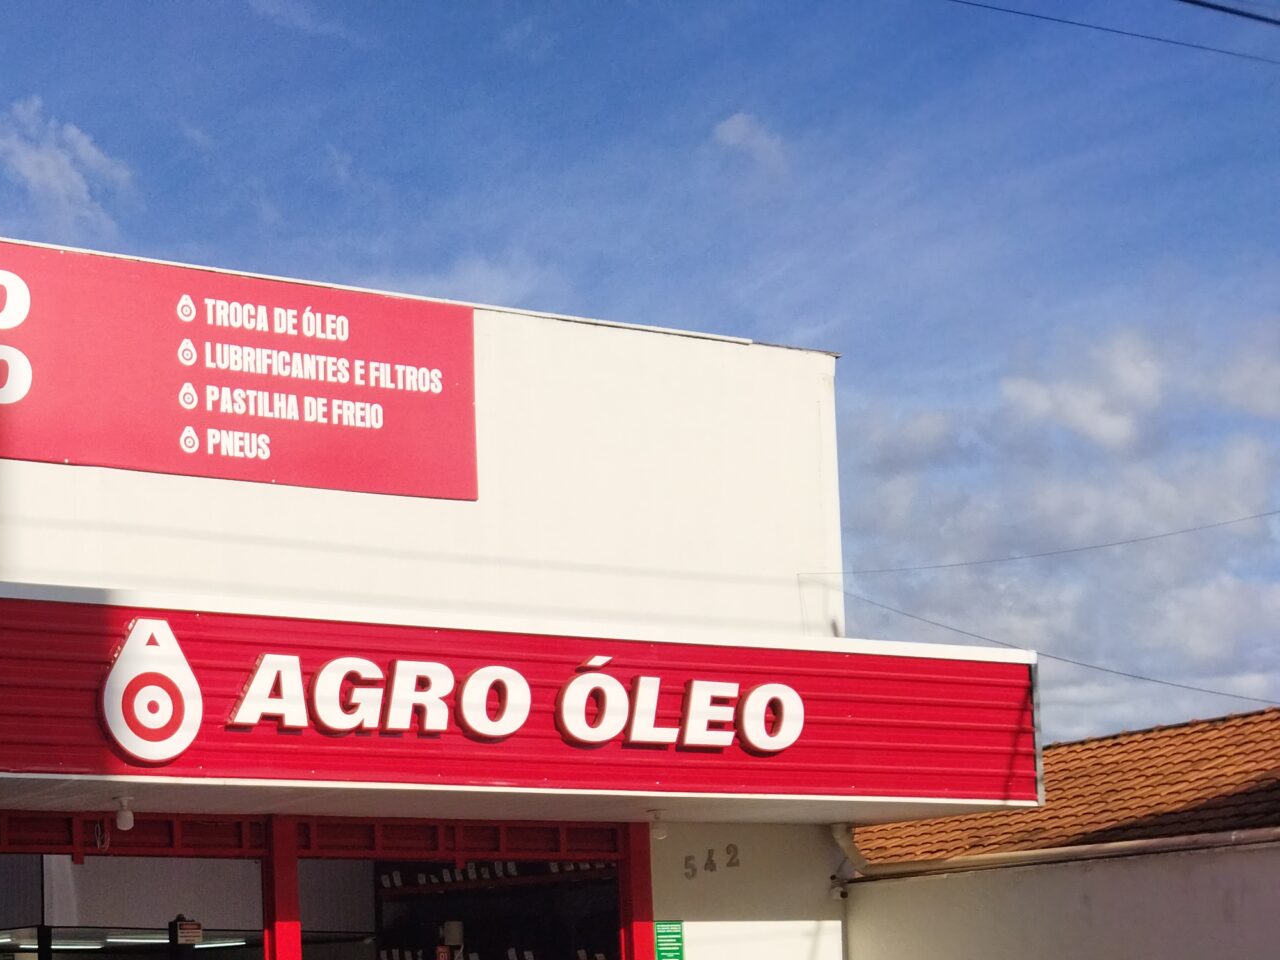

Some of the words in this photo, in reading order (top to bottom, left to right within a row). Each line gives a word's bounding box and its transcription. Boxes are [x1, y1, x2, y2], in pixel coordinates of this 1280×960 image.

[204, 298, 269, 332] TROCA
[273, 307, 298, 336] DE
[302, 305, 350, 342] ÓLEO
[204, 341, 350, 384] LUBRIFICANTES
[354, 359, 365, 386] E
[369, 361, 443, 394] FILTROS
[206, 385, 299, 421] PASTILHA
[304, 396, 328, 424] DE
[332, 399, 384, 429] FREIO
[207, 428, 271, 460] PNEUS
[225, 652, 532, 740] AGRO
[558, 655, 806, 754] ÓLEO
[684, 843, 740, 880] 542
